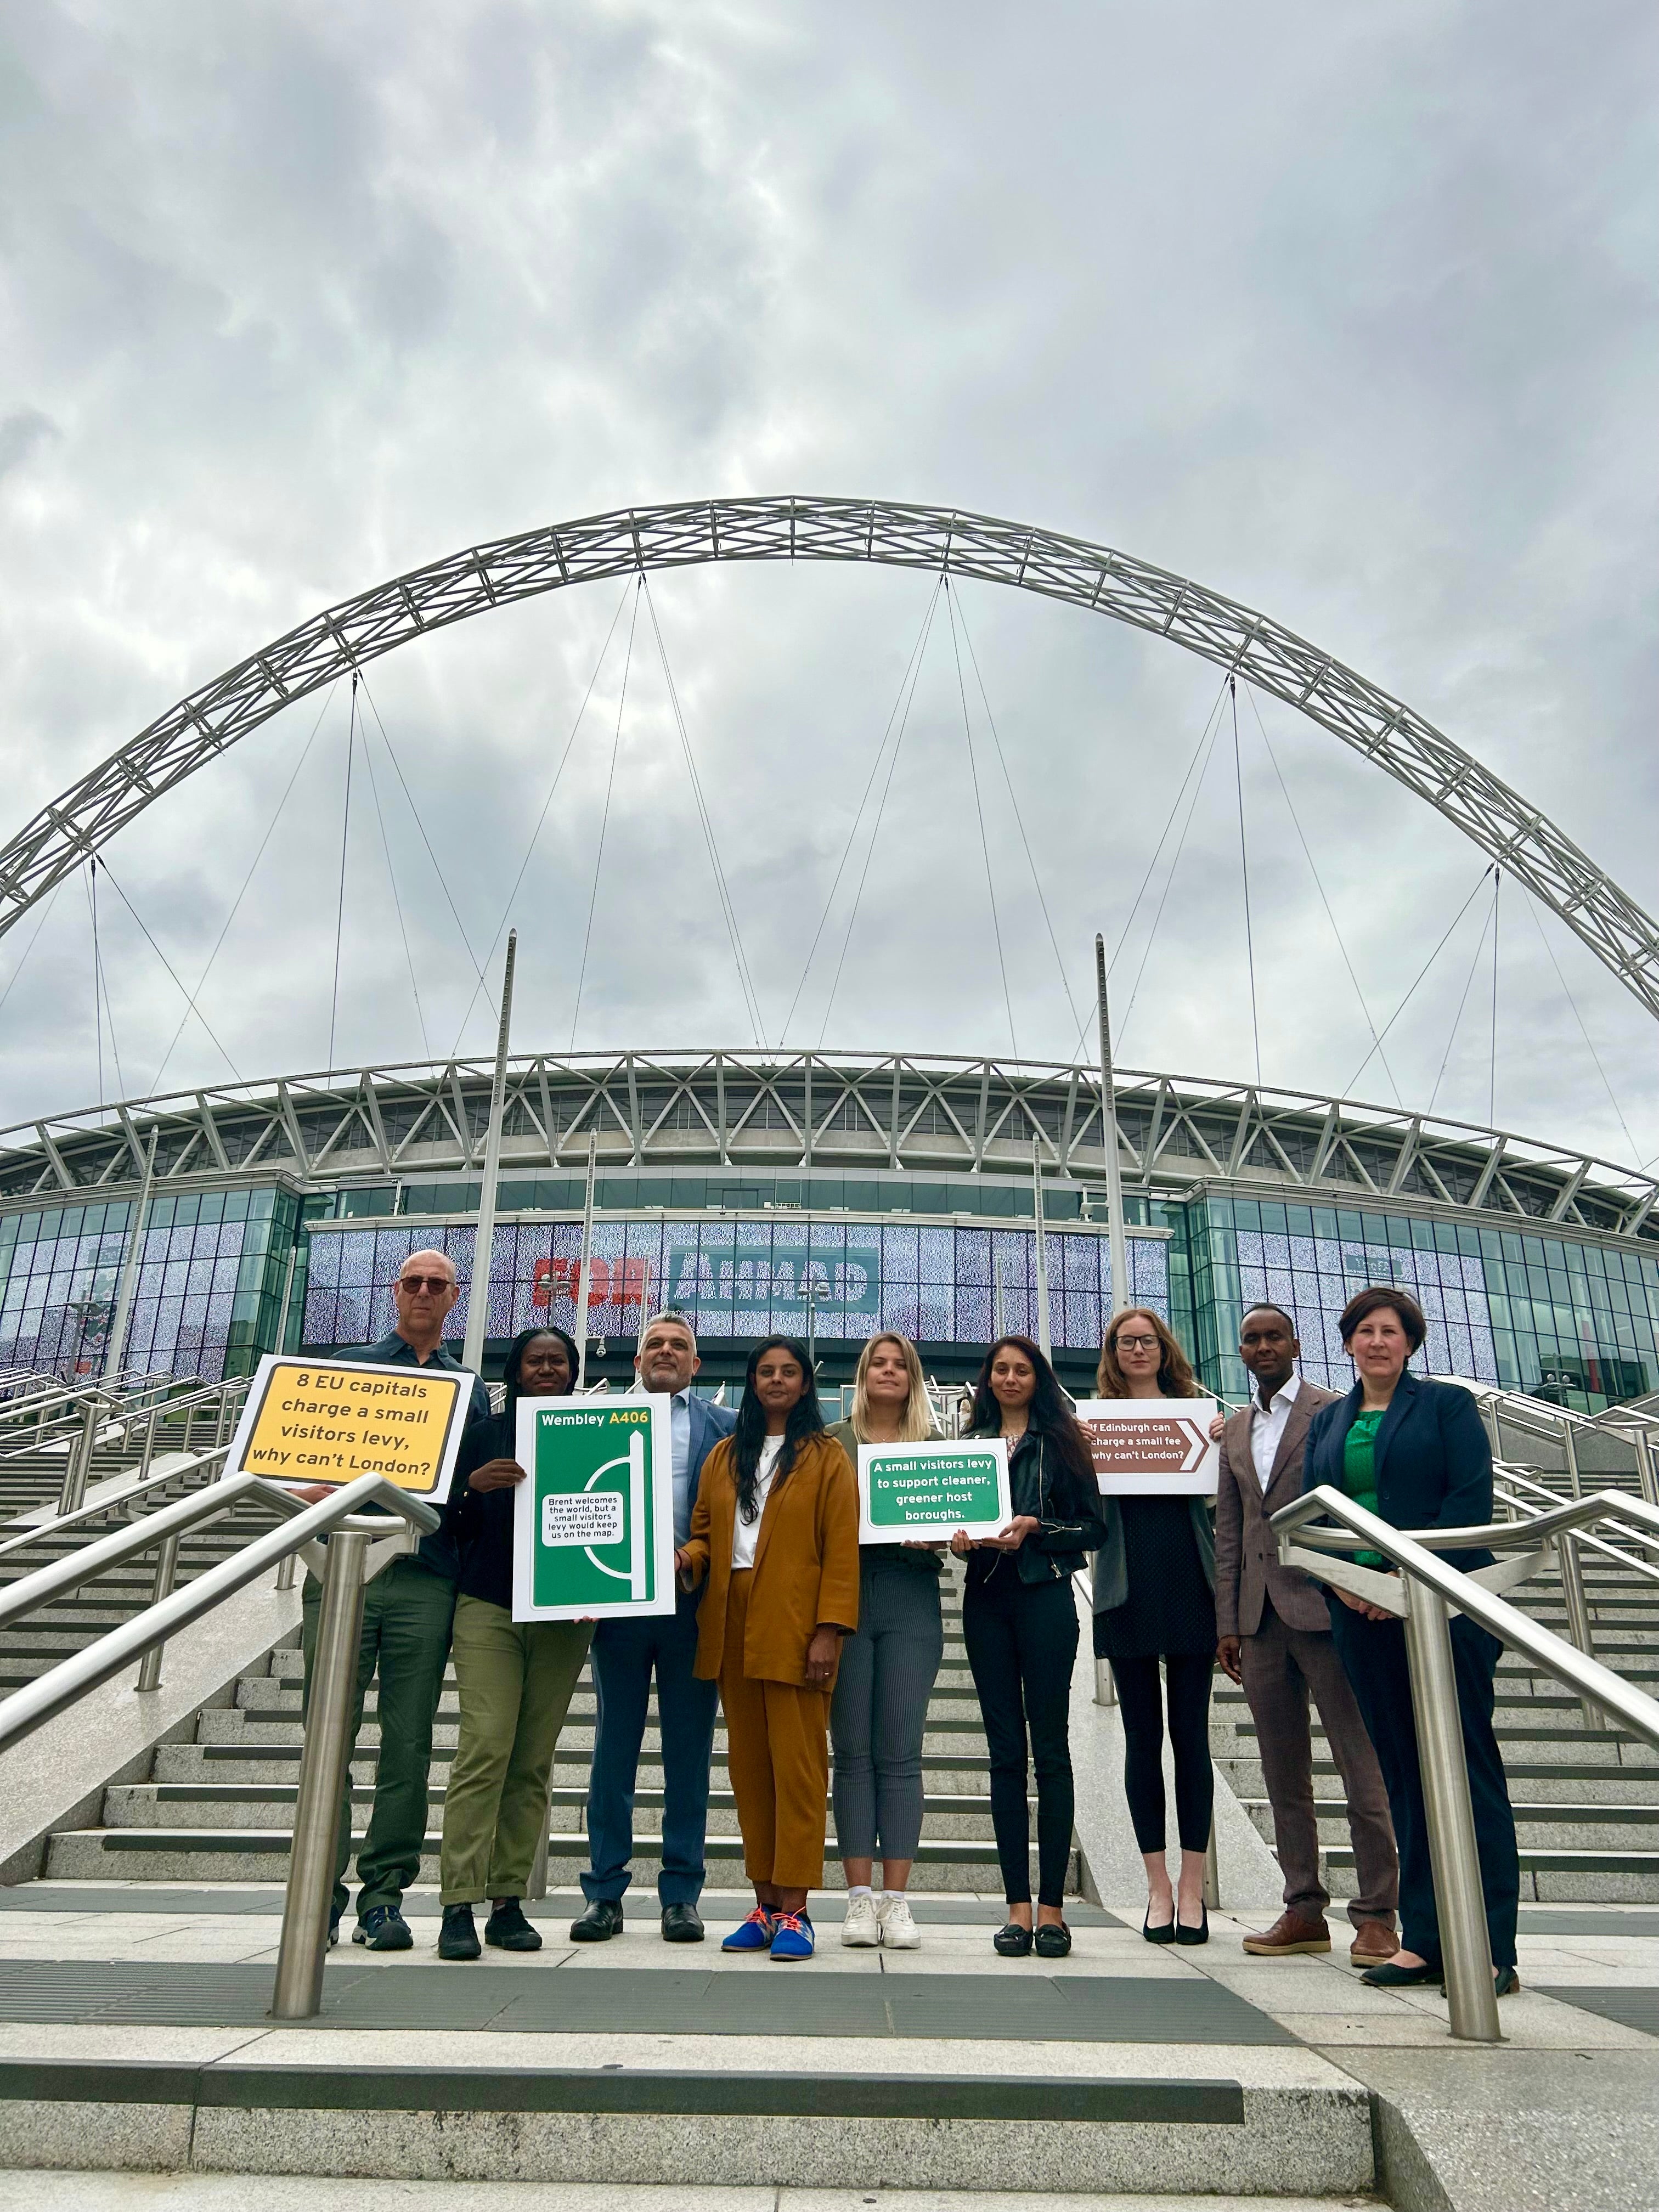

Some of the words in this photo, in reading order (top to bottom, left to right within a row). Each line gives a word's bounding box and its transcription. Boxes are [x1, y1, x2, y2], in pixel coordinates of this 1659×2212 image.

[673, 1252, 868, 1301] AHMAD
[297, 1374, 309, 1386] 8
[315, 1375, 345, 1390] EU
[349, 1381, 427, 1398] capitals
[281, 1398, 351, 1418] charge
[357, 1407, 369, 1418] a
[374, 1408, 430, 1424] small
[541, 1413, 605, 1426] Wembley
[609, 1412, 648, 1424] A406
[1099, 1423, 1150, 1433] Edinburgh
[281, 1424, 356, 1442] visitors
[362, 1430, 409, 1451] levy,
[1091, 1437, 1125, 1447] charge
[1136, 1437, 1163, 1445] small
[1165, 1437, 1181, 1445] fee
[253, 1447, 291, 1465] why
[296, 1452, 344, 1467] can't
[349, 1455, 431, 1475] London?
[1092, 1451, 1111, 1460] why
[1114, 1451, 1139, 1459] can't
[1142, 1451, 1184, 1459] London?
[873, 1463, 883, 1472] A
[885, 1461, 917, 1471] small
[919, 1460, 964, 1470] visitors
[967, 1459, 992, 1469] levy
[877, 1479, 889, 1488] to
[893, 1476, 939, 1489] support
[941, 1476, 990, 1486] cleaner,
[896, 1494, 943, 1506] greener
[946, 1492, 973, 1502] host
[905, 1509, 965, 1521] boroughs.
